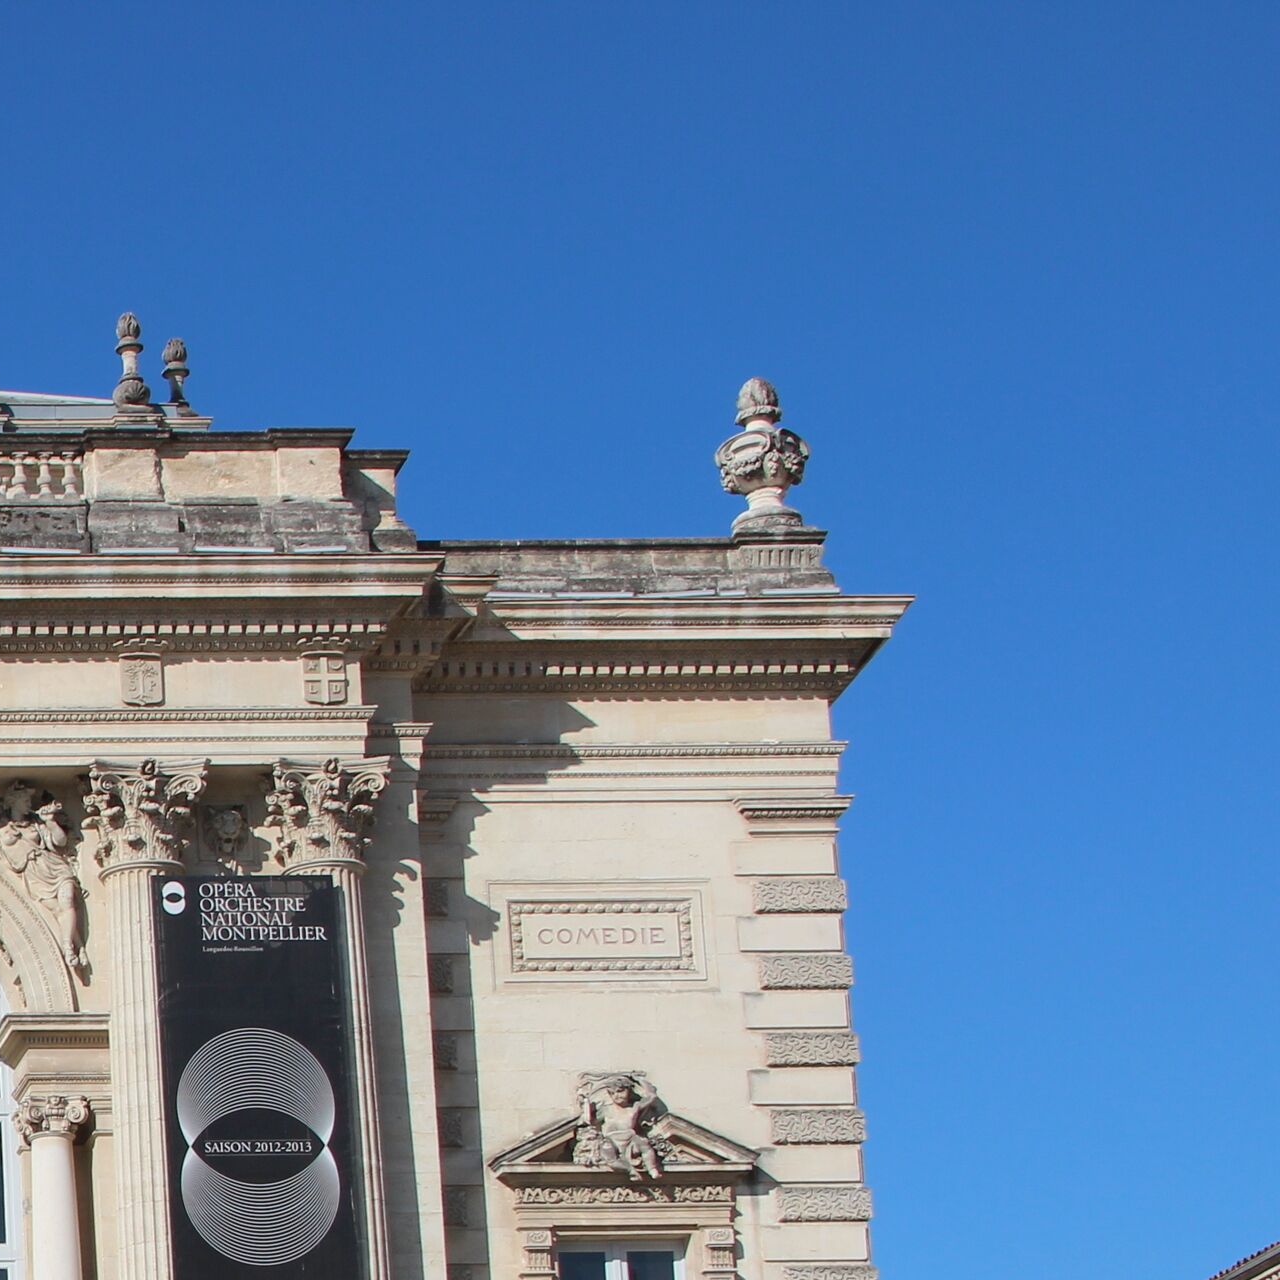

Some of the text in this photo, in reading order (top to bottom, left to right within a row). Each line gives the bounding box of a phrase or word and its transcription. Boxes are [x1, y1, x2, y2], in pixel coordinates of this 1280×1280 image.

[198, 880, 256, 898] OPÉRA
[199, 898, 306, 912] ORCHESTRE
[200, 912, 292, 926] NATIONAL
[201, 926, 328, 941] MONTPELLIER
[537, 927, 666, 945] COMEDIE
[204, 1141, 312, 1153] SAISON 2012-2013
